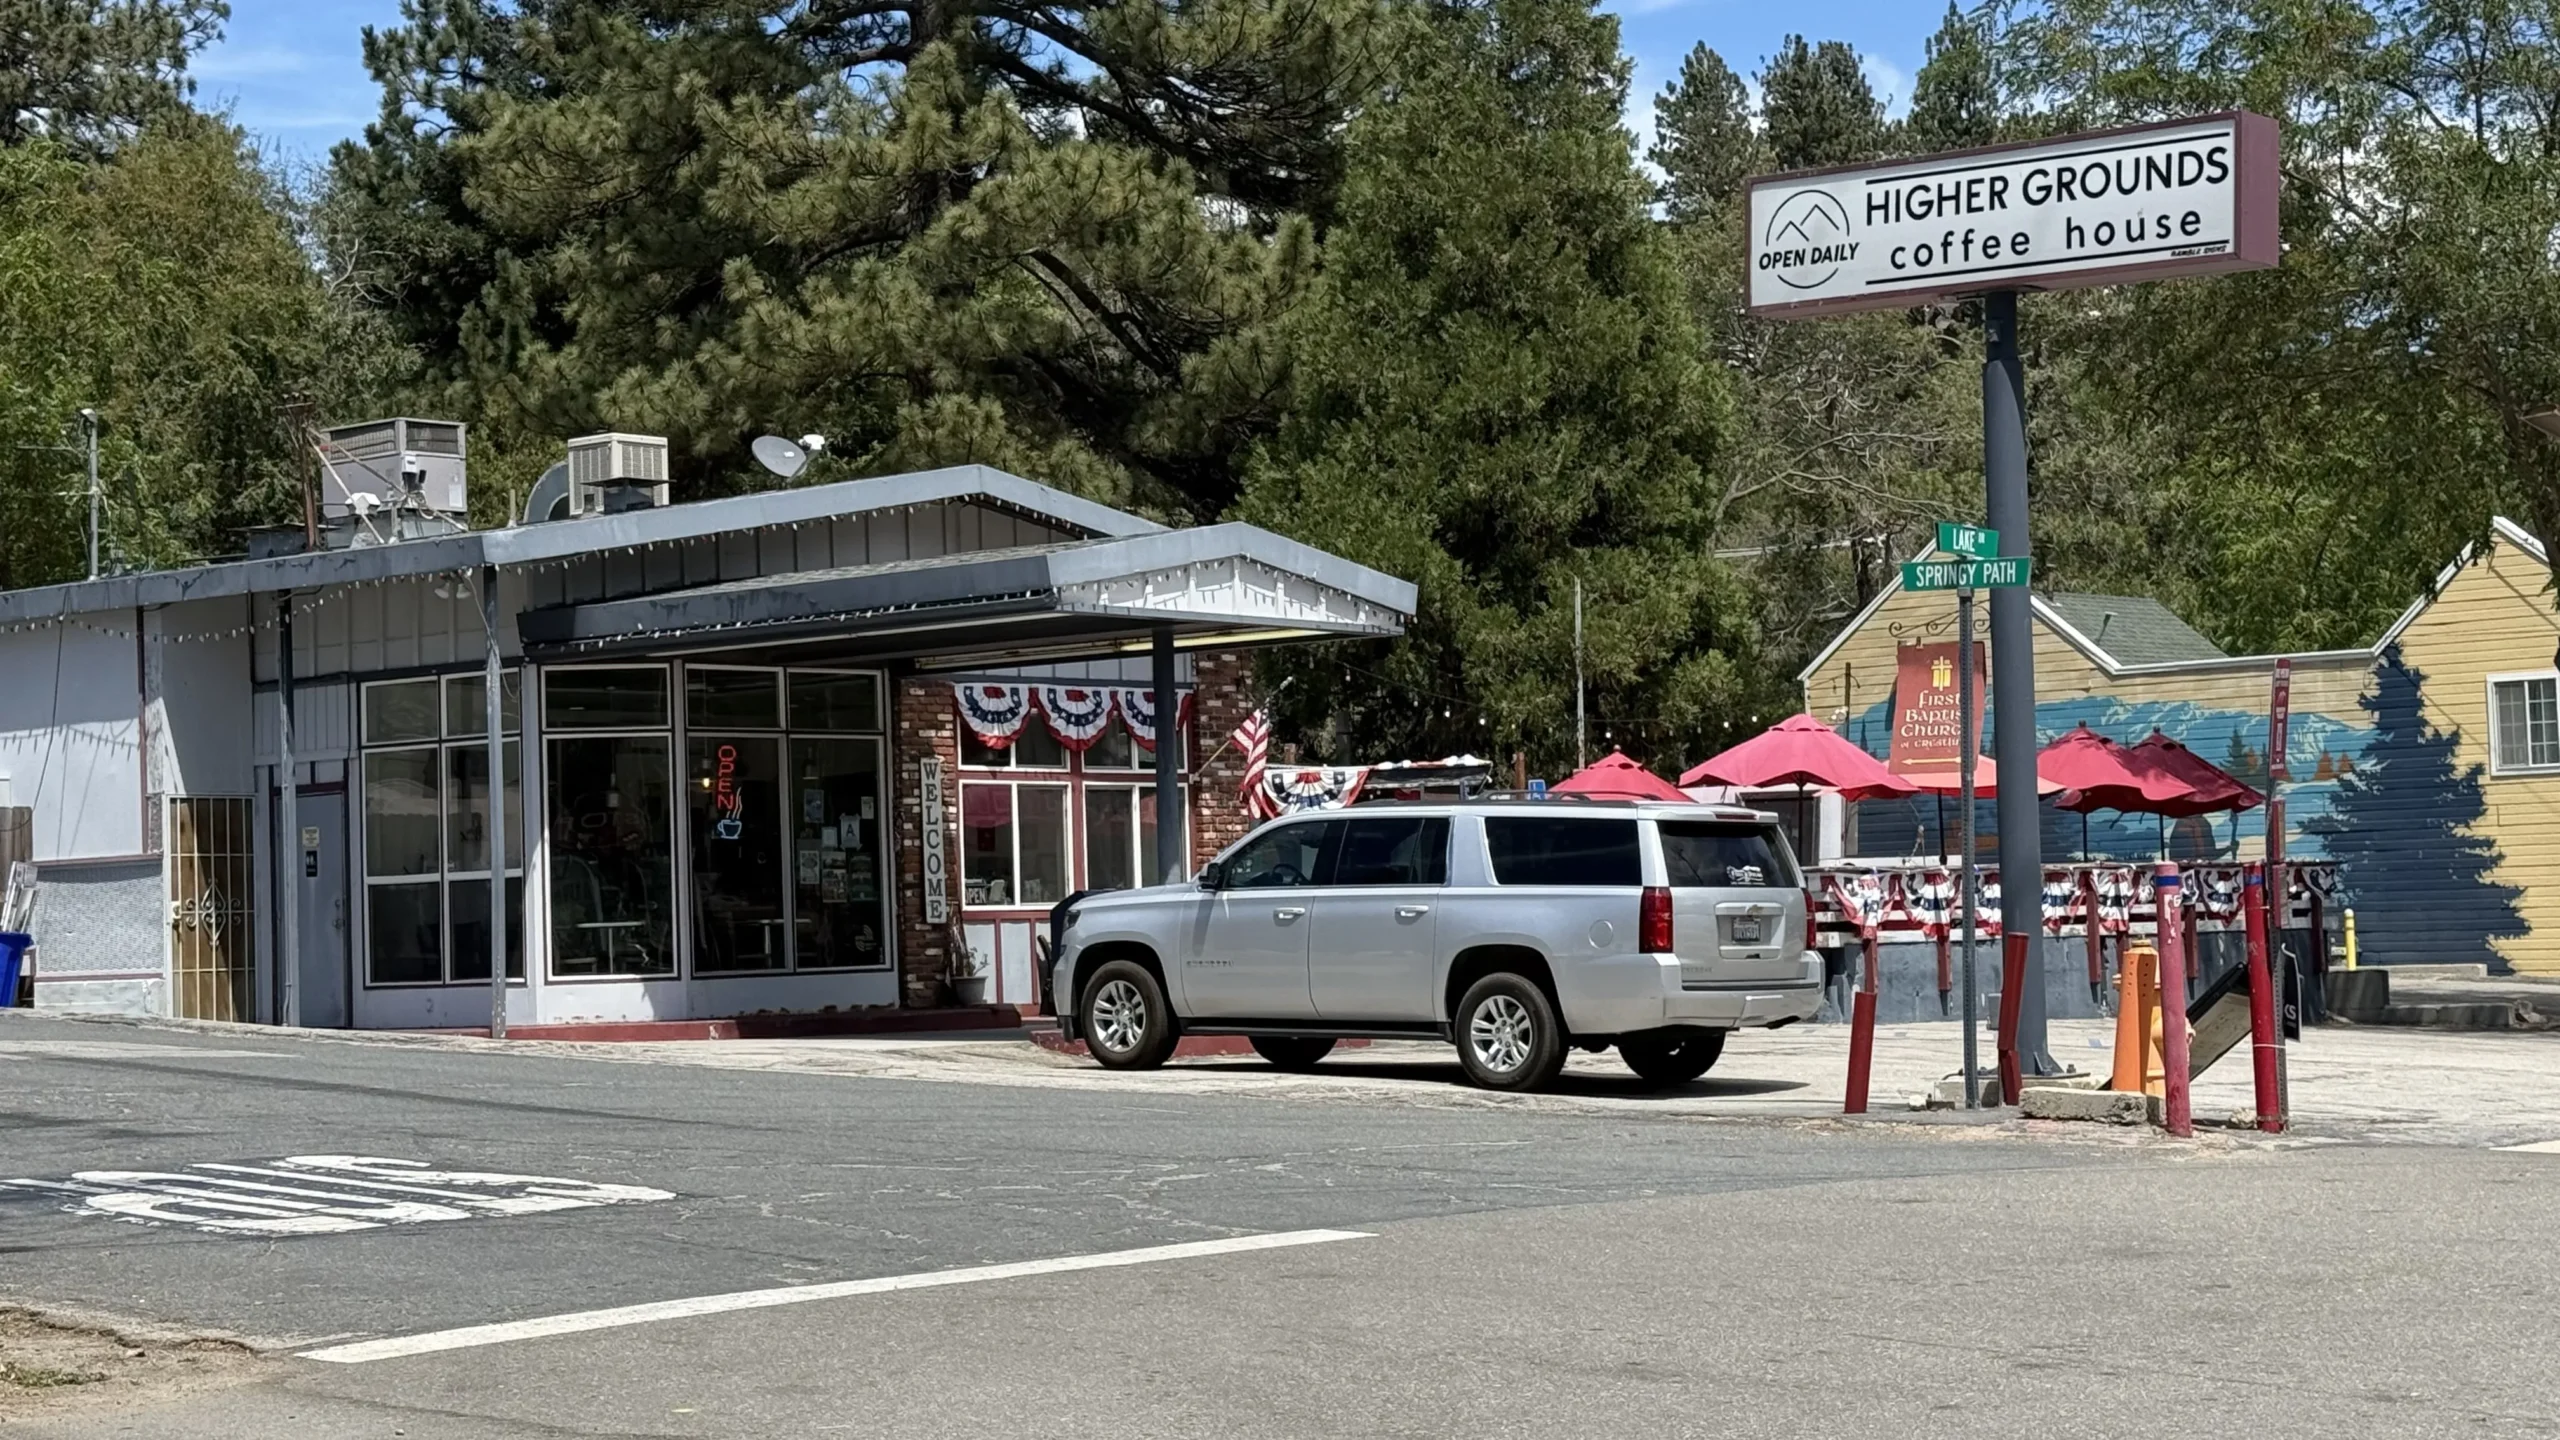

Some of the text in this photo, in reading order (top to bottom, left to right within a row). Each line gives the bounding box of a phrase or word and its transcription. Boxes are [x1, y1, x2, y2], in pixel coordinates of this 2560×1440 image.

[1866, 146, 2230, 226] HIGHER GROUNDS
[1890, 210, 2201, 270] coffee house
[1759, 242, 1860, 271] OPEN DAILY
[1952, 527, 1976, 552] LAKE
[1915, 561, 2016, 587] SPRINGY PATH
[1901, 723, 1962, 737] Churc
[1905, 709, 1962, 724] Baptis
[718, 745, 737, 810] OPEN
[845, 823, 855, 837] A
[923, 762, 943, 920] WELCOME
